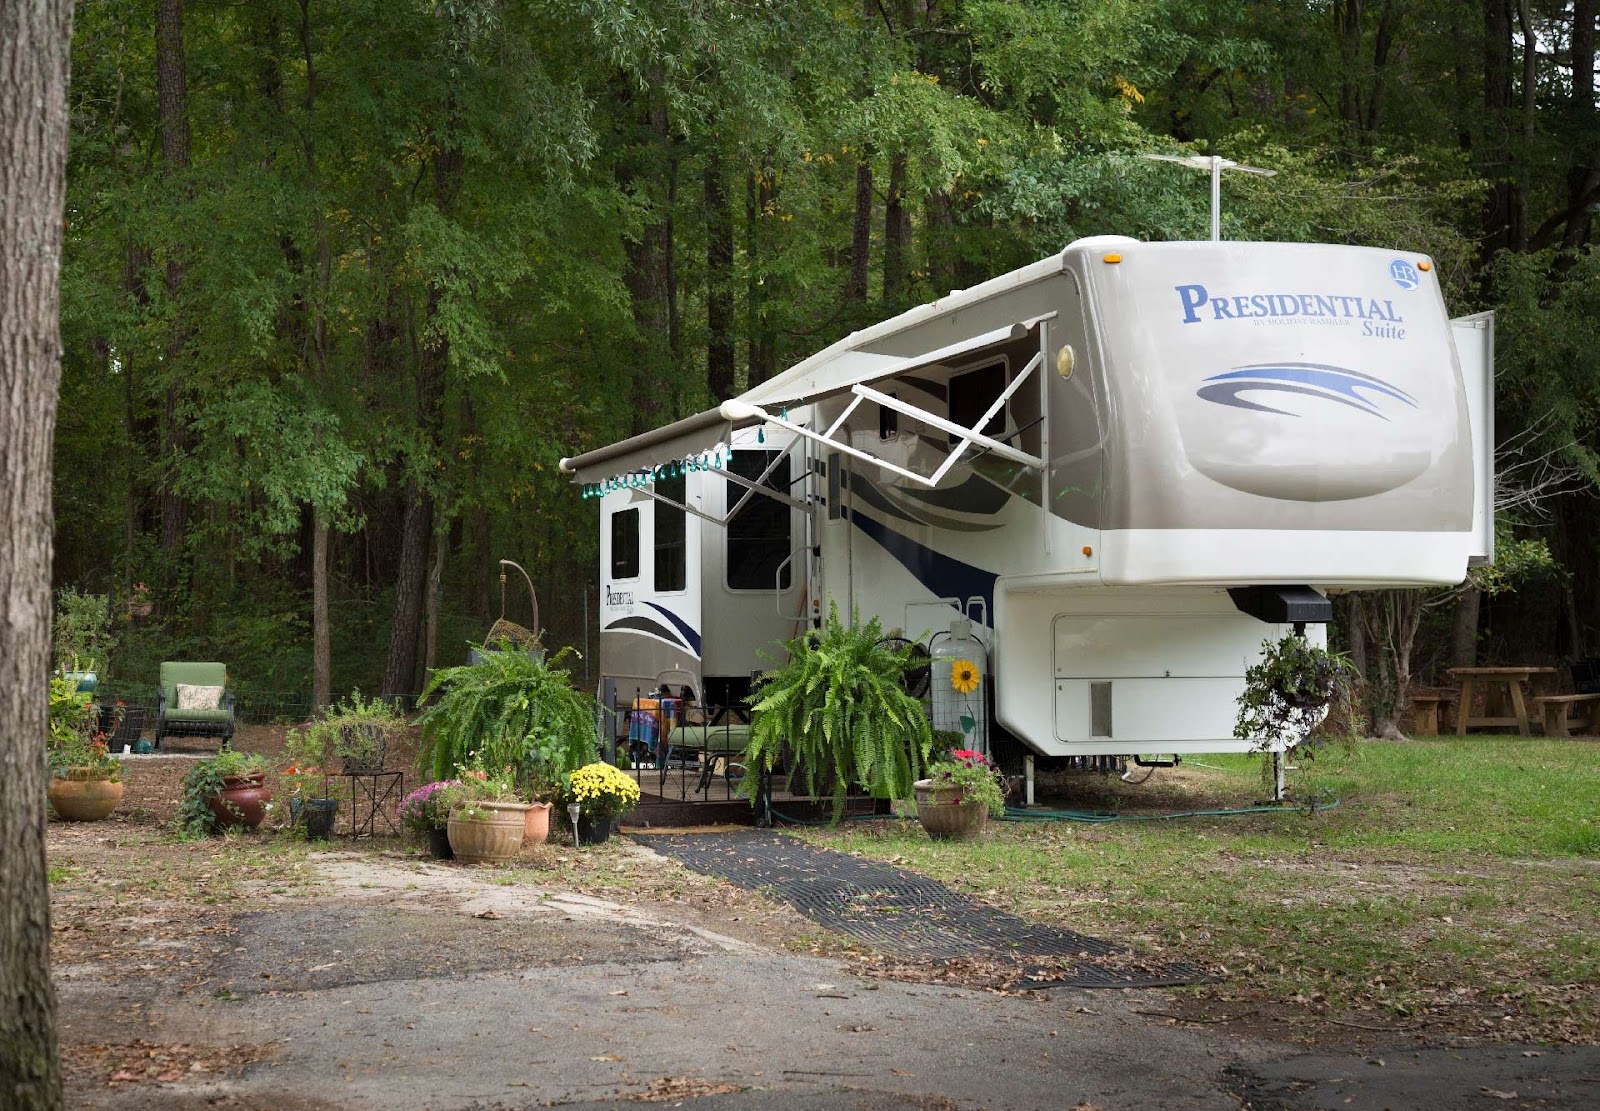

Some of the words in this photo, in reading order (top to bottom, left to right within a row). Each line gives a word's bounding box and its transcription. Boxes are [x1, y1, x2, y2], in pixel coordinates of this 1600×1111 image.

[1393, 265, 1416, 280] HR
[1175, 284, 1403, 324] PRESIDENTIAL
[1362, 321, 1406, 340] Suite
